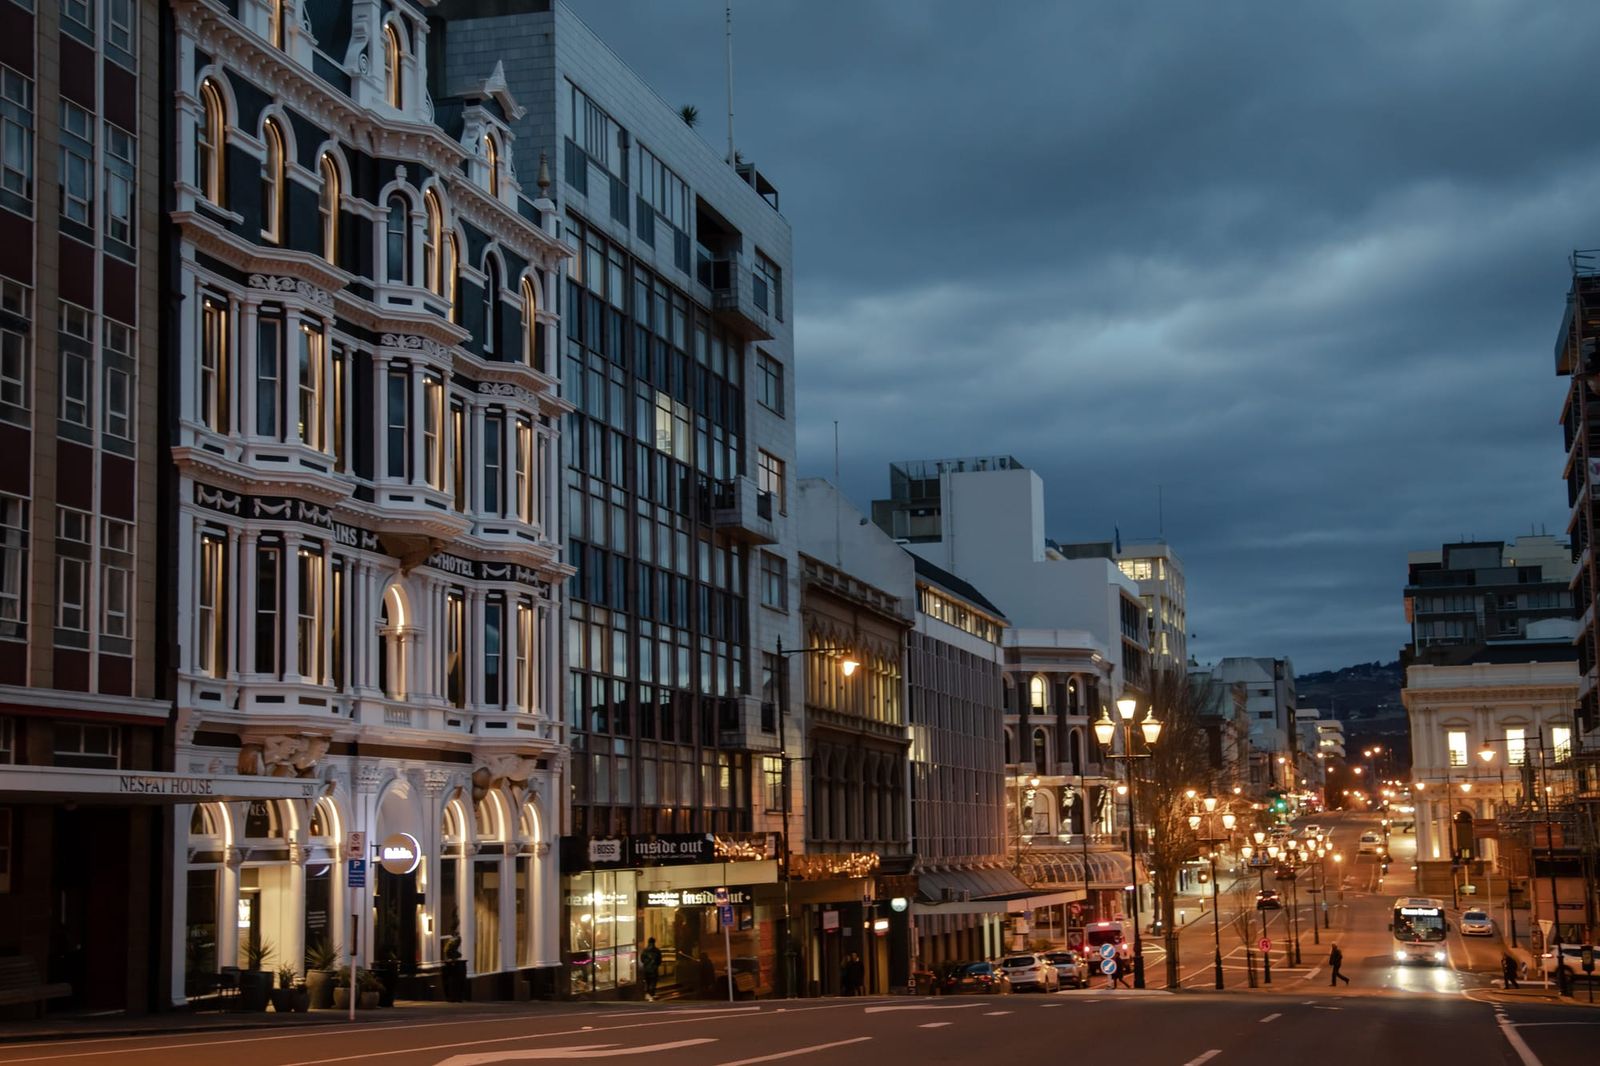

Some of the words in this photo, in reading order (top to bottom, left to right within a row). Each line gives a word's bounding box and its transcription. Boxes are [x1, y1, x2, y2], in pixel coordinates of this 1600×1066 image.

[442, 554, 475, 577] HOTEL
[171, 778, 213, 795] HOUSE
[597, 844, 615, 855] BOSS
[635, 839, 676, 855] inside
[680, 839, 703, 853] out
[353, 860, 361, 869] P
[682, 890, 717, 905] insid
[727, 890, 744, 904] ut
